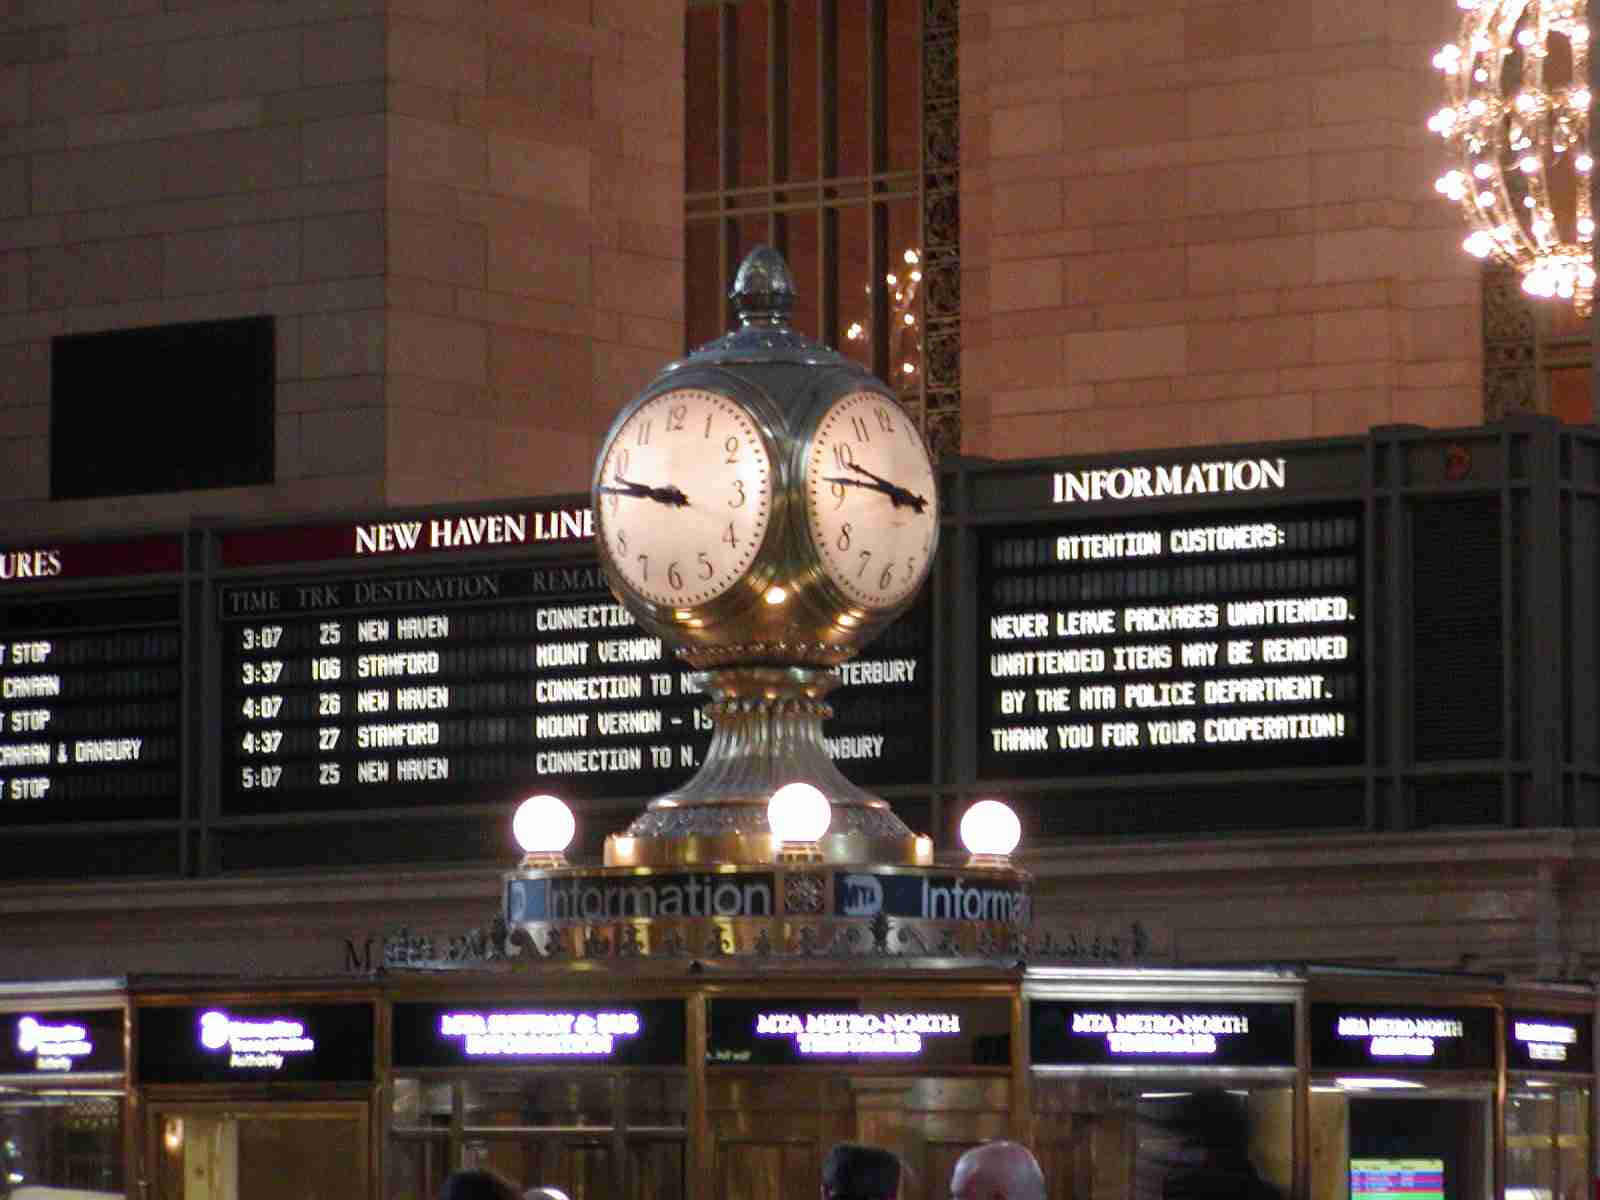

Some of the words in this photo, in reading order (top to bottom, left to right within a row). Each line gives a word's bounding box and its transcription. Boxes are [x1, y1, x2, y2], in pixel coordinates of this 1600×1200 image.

[1053, 458, 1287, 502] INFORMATION
[356, 522, 422, 553] NEW
[430, 515, 526, 548] HAVEN
[1056, 531, 1161, 560] ATTENTION
[1170, 523, 1286, 555] CUSTOMERS:
[0, 551, 62, 579] URES
[230, 590, 281, 612] TIME
[298, 585, 341, 608] TRK
[354, 575, 498, 604] DESTINATION
[357, 620, 389, 642] NEW
[397, 616, 449, 640] HAVEN
[536, 604, 635, 632] CONNECTIO
[990, 613, 1049, 640] NEVER
[1056, 610, 1116, 637] LEAVE
[1124, 604, 1218, 633] PACKAGES
[1227, 597, 1355, 626] UNATTENDED.
[242, 626, 283, 650] 3:07
[319, 623, 341, 645] 25
[12, 642, 51, 665] STOP
[357, 652, 440, 677] STAMFORD
[536, 641, 588, 669] MOUNT
[597, 637, 662, 664] VERNON
[990, 648, 1105, 678] UNATTENDED
[1113, 645, 1173, 671] ITEMS
[1182, 642, 1218, 668] MAY
[1227, 640, 1254, 665] BE
[1263, 636, 1348, 663] REMOVED
[242, 660, 283, 685] 3:37
[312, 657, 341, 681] 106
[357, 689, 389, 713] NEW
[397, 686, 449, 710] HAVEN
[536, 677, 642, 705] CONNECTION
[651, 673, 671, 697] TO
[1001, 689, 1027, 715] BY
[1035, 687, 1071, 713] THE
[1079, 685, 1116, 710] MTA
[1124, 682, 1196, 709] POLICE
[1204, 675, 1334, 705] DEPARTMENT.
[242, 695, 283, 719] 4:07
[319, 692, 341, 715] 26
[11, 708, 51, 732] STOP
[536, 714, 589, 740] MOUNT
[597, 709, 661, 736] VERNON
[991, 727, 1049, 752] THANK
[1057, 724, 1093, 748] YOU
[1102, 722, 1139, 747] FOR
[1148, 720, 1196, 745] YOUR
[1204, 714, 1345, 743] COOPERATION!
[242, 730, 283, 754] 4:37
[319, 727, 341, 750] 27
[357, 722, 440, 748] STAMFORD
[57, 741, 68, 764] &
[75, 737, 142, 763] DANBURY
[536, 746, 642, 775] CONNECTION
[651, 745, 671, 770] TO
[242, 766, 283, 789] 5:07
[319, 762, 341, 785] 25
[357, 759, 389, 782] NEW
[397, 757, 449, 780] HAVEN
[11, 777, 50, 801] STOP
[544, 875, 772, 922] Information
[756, 1013, 803, 1034] MTA
[1072, 1013, 1114, 1034] MTA
